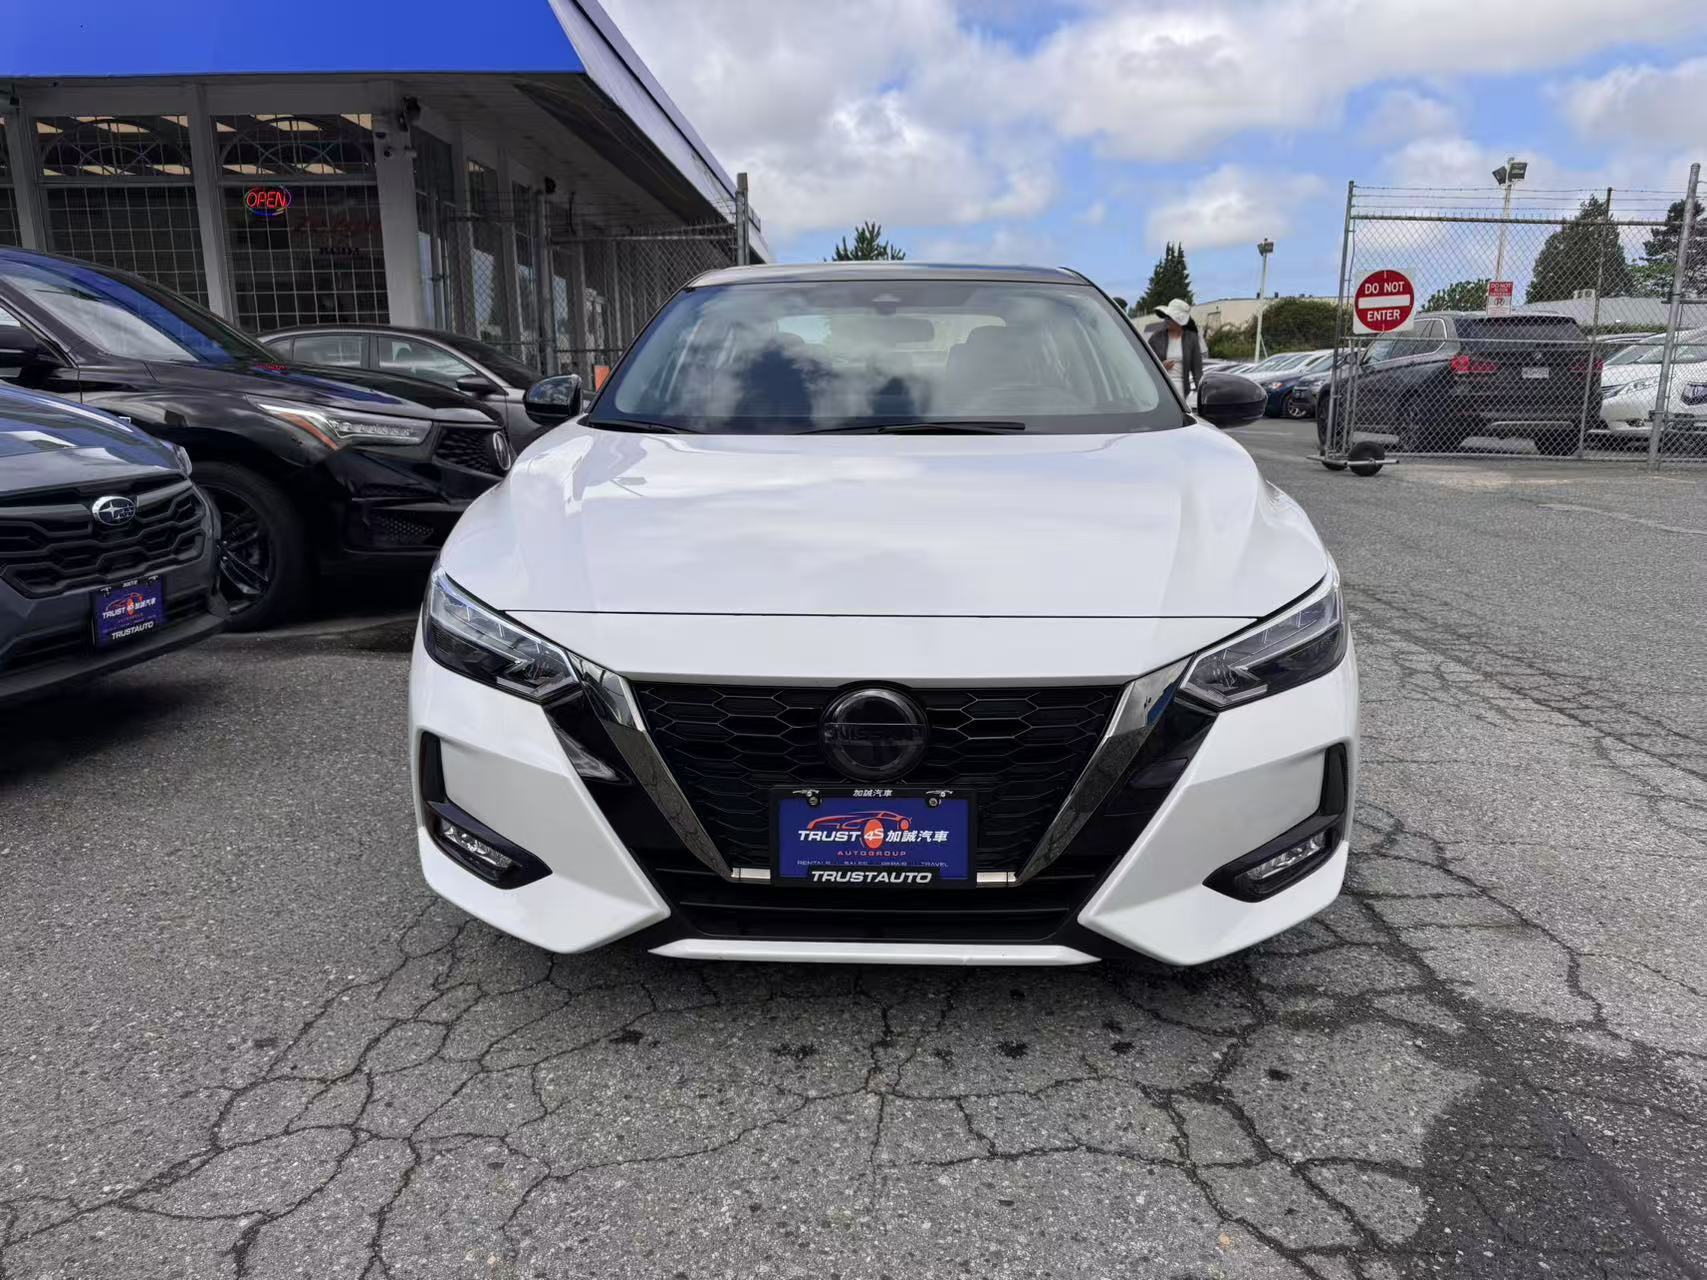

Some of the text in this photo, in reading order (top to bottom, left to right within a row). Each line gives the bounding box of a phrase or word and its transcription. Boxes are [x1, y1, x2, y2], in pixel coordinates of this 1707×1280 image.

[246, 191, 287, 208] OPEN
[1364, 281, 1405, 294] DO NOT
[1367, 309, 1401, 322] ENTER
[111, 620, 154, 640] TRUSTAUTO
[798, 828, 950, 843] TRUST 4S 加誠汽車
[811, 871, 933, 883] TRUSTAUTO
